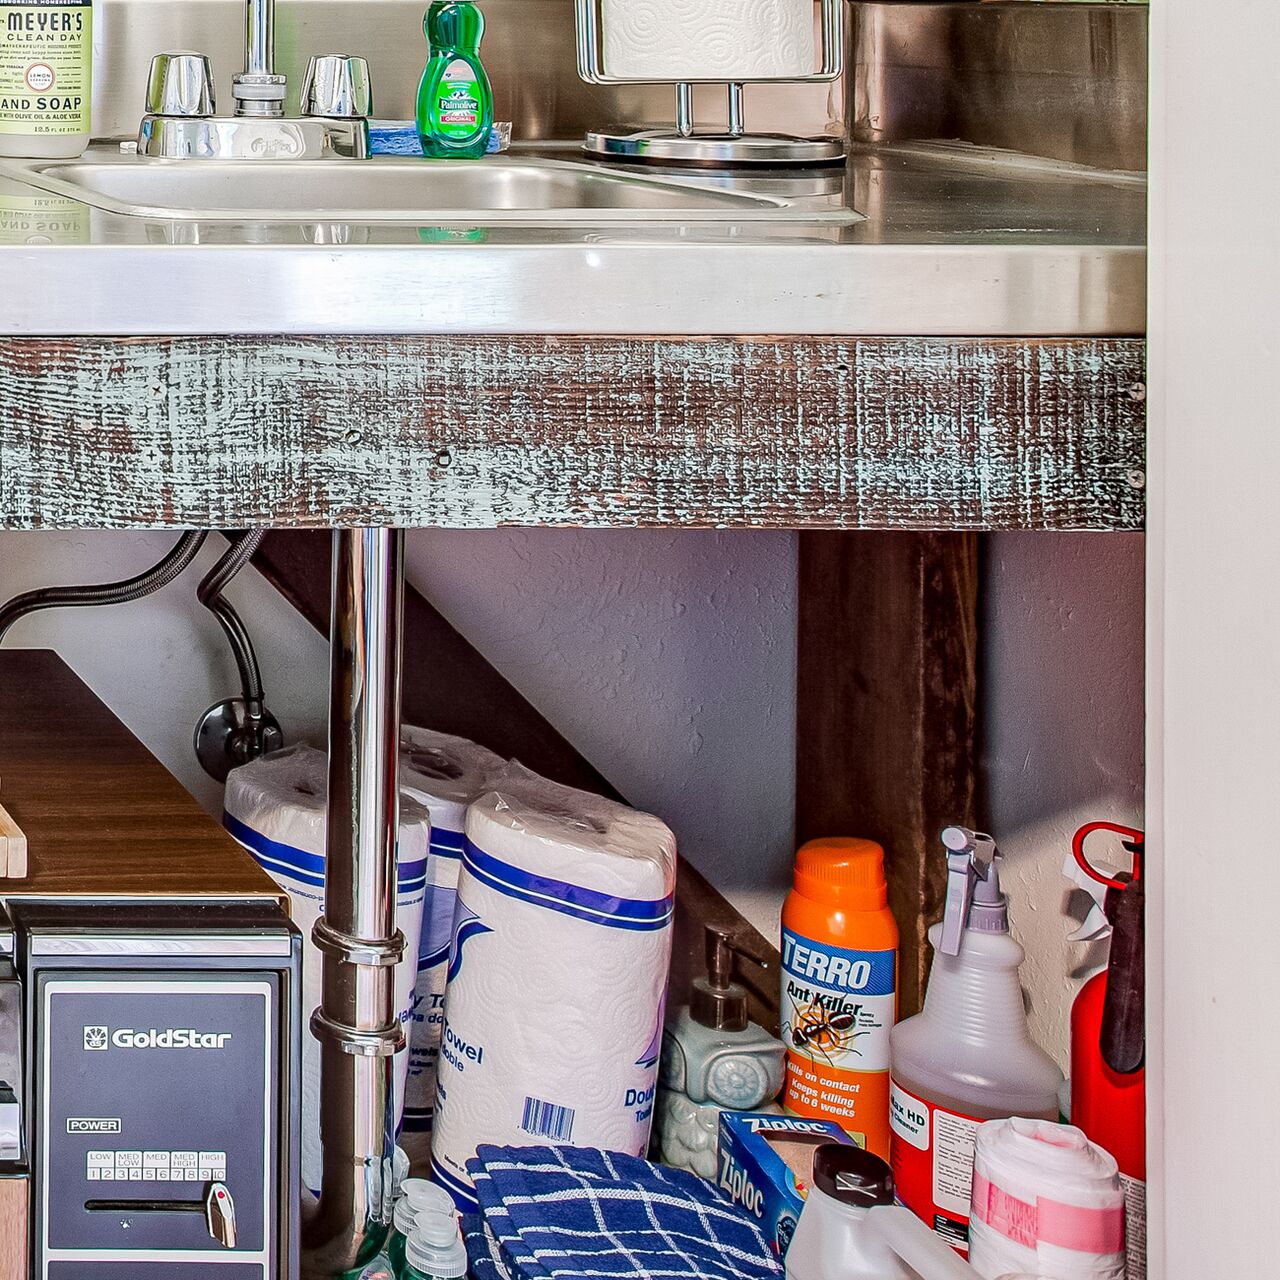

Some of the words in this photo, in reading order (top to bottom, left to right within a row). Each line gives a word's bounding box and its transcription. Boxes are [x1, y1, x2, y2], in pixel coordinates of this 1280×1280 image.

[8, 12, 82, 31] MEYER'S
[7, 33, 54, 41] CLEAN
[37, 98, 81, 110] SOAP
[441, 100, 477, 109] Palmolive
[783, 933, 870, 990] TERRO
[787, 980, 810, 1003] Ant
[814, 993, 863, 1016] Killer
[112, 1028, 232, 1048] GoldStar
[444, 1018, 483, 1064] Towel
[792, 1078, 818, 1097] Keeps
[821, 1090, 855, 1108] killing
[805, 1073, 817, 1083] on
[820, 1076, 861, 1093] contact
[789, 1089, 798, 1100] up
[801, 1093, 810, 1105] to
[811, 1098, 818, 1108] 6
[820, 1101, 855, 1118] weeks
[70, 1121, 117, 1130] POWER
[742, 1119, 828, 1133] Ziploc
[894, 1114, 919, 1134] Cleaner
[907, 1109, 925, 1126] HD
[720, 1148, 763, 1218] Ziploc
